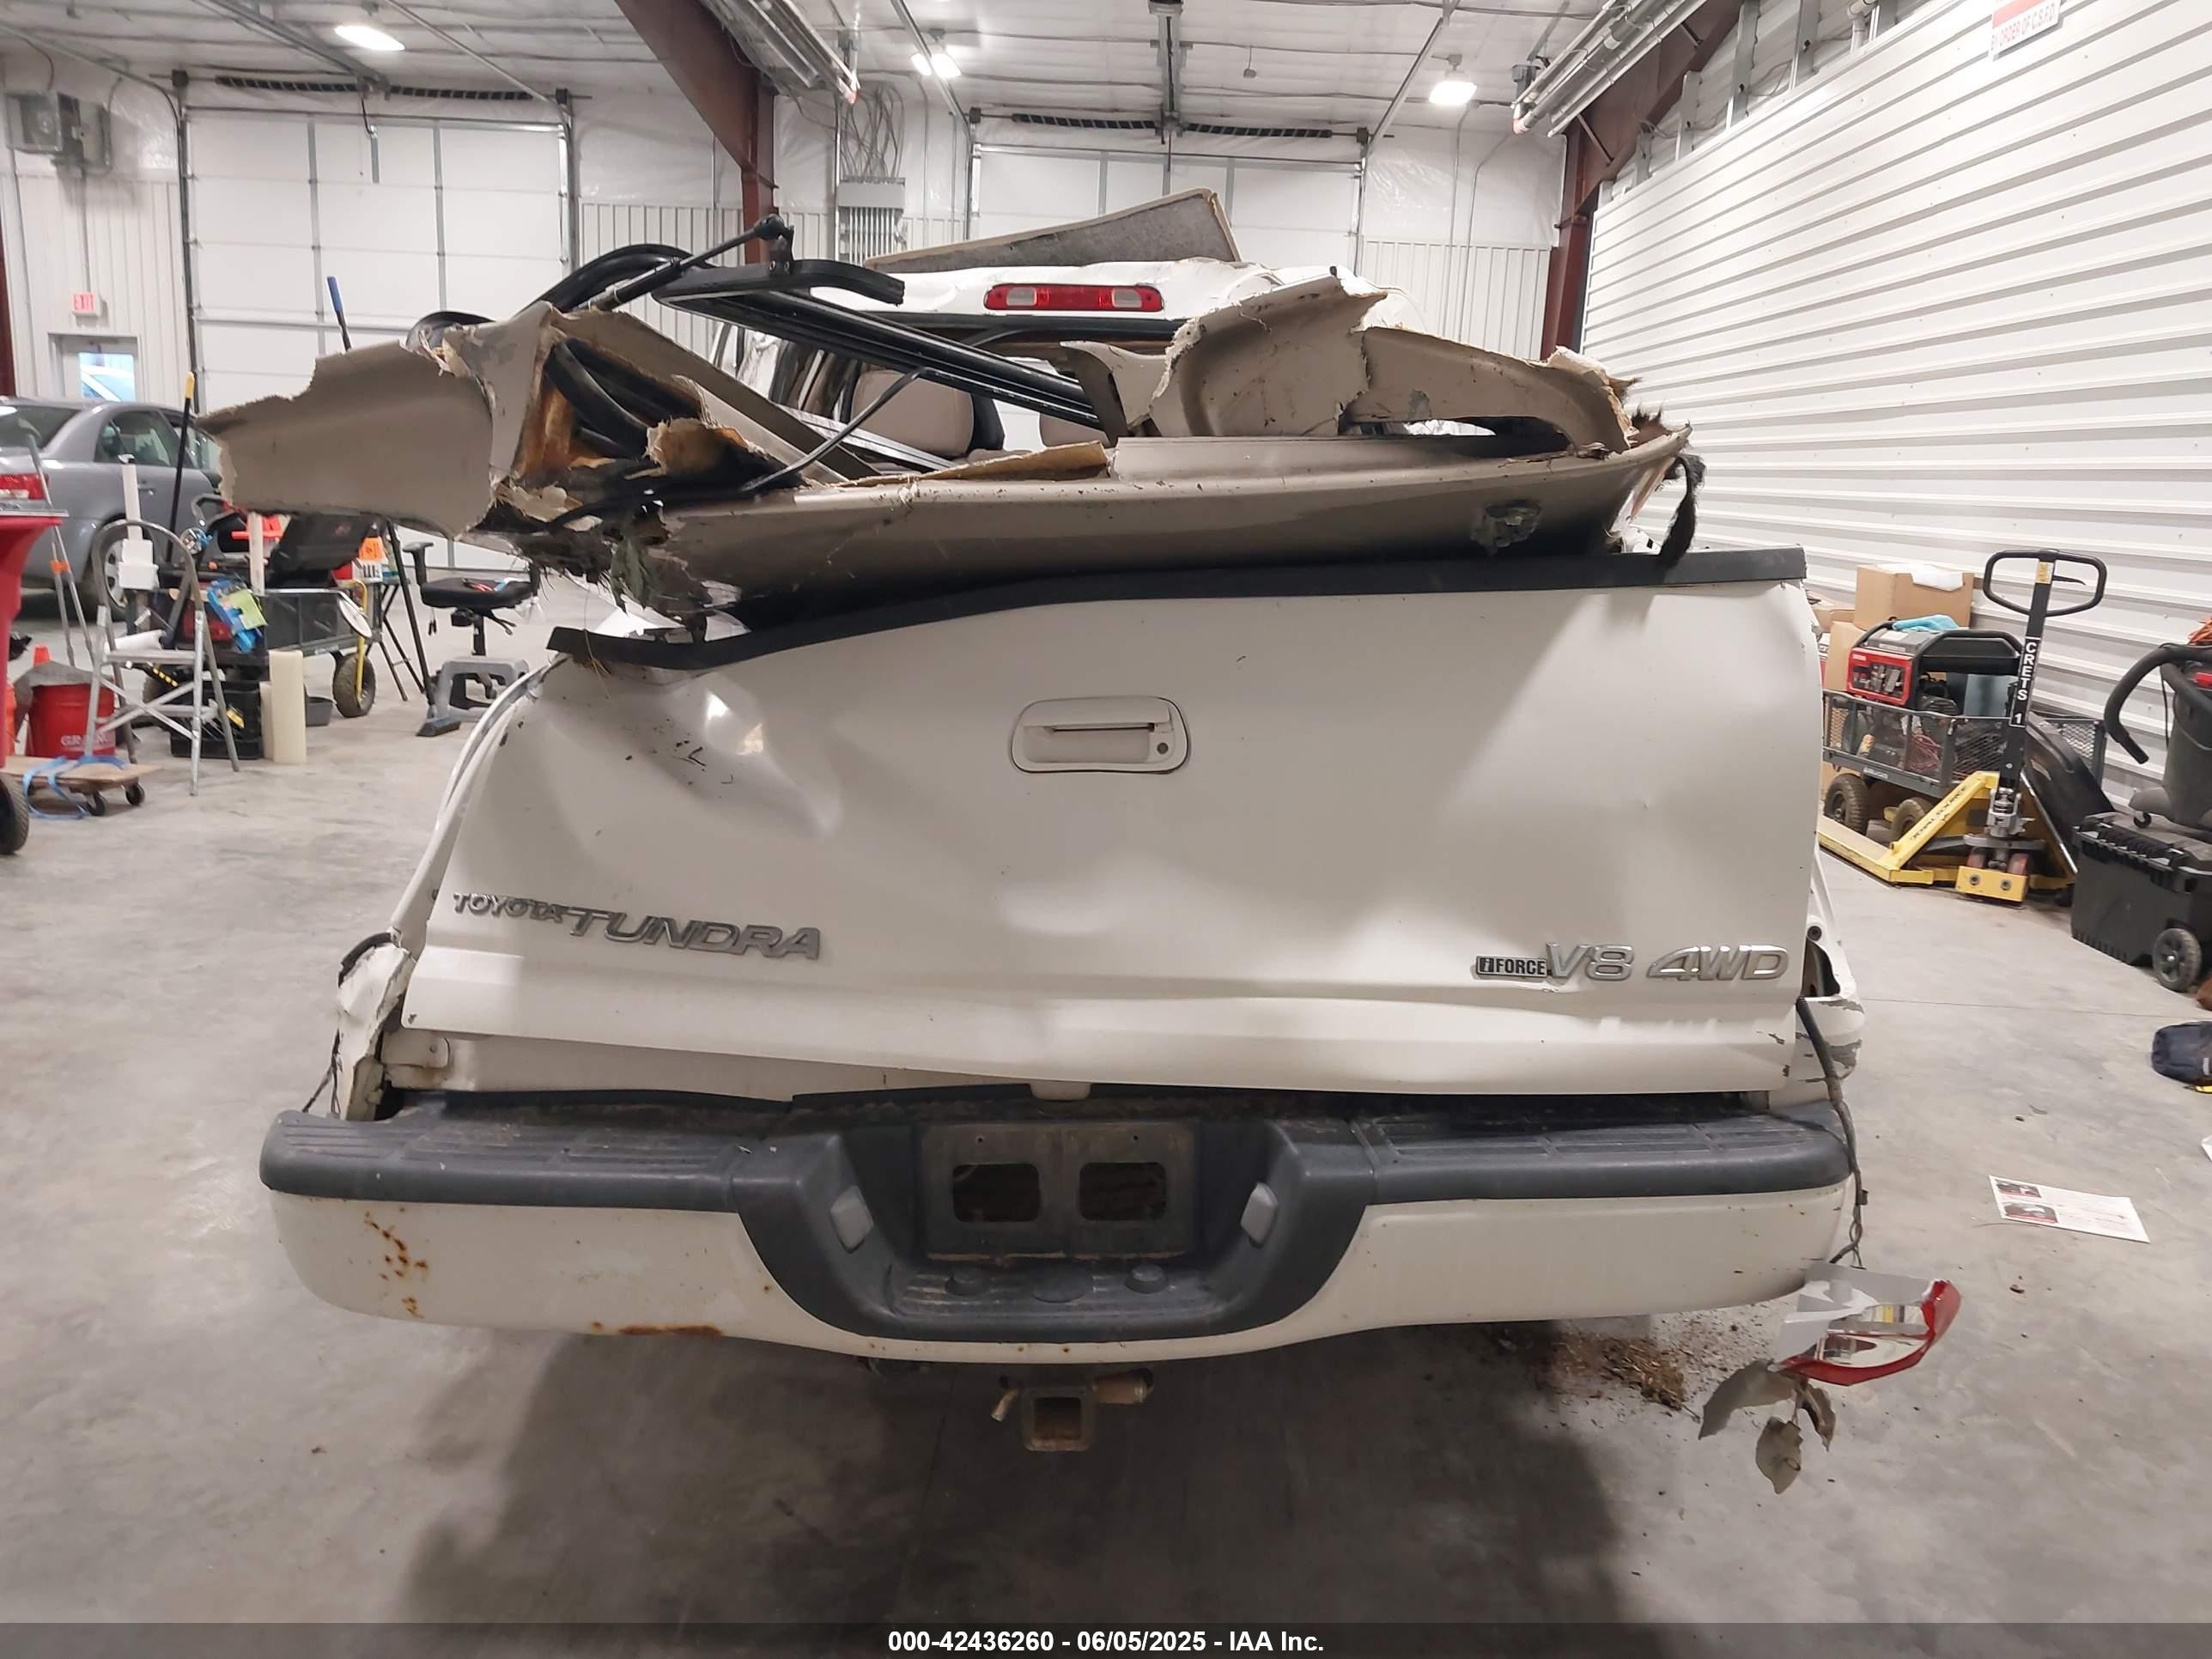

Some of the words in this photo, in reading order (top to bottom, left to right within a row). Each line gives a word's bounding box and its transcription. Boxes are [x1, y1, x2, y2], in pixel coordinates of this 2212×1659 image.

[1998, 20, 2021, 47] ORDER
[73, 294, 94, 310] EXIT
[2016, 641, 2038, 701] CRETS
[2014, 713, 2023, 724] 1
[453, 892, 563, 924] TOYOTA
[563, 904, 822, 960] TUNDRA
[1547, 943, 1635, 981] V8
[1645, 944, 1789, 981] 4WD
